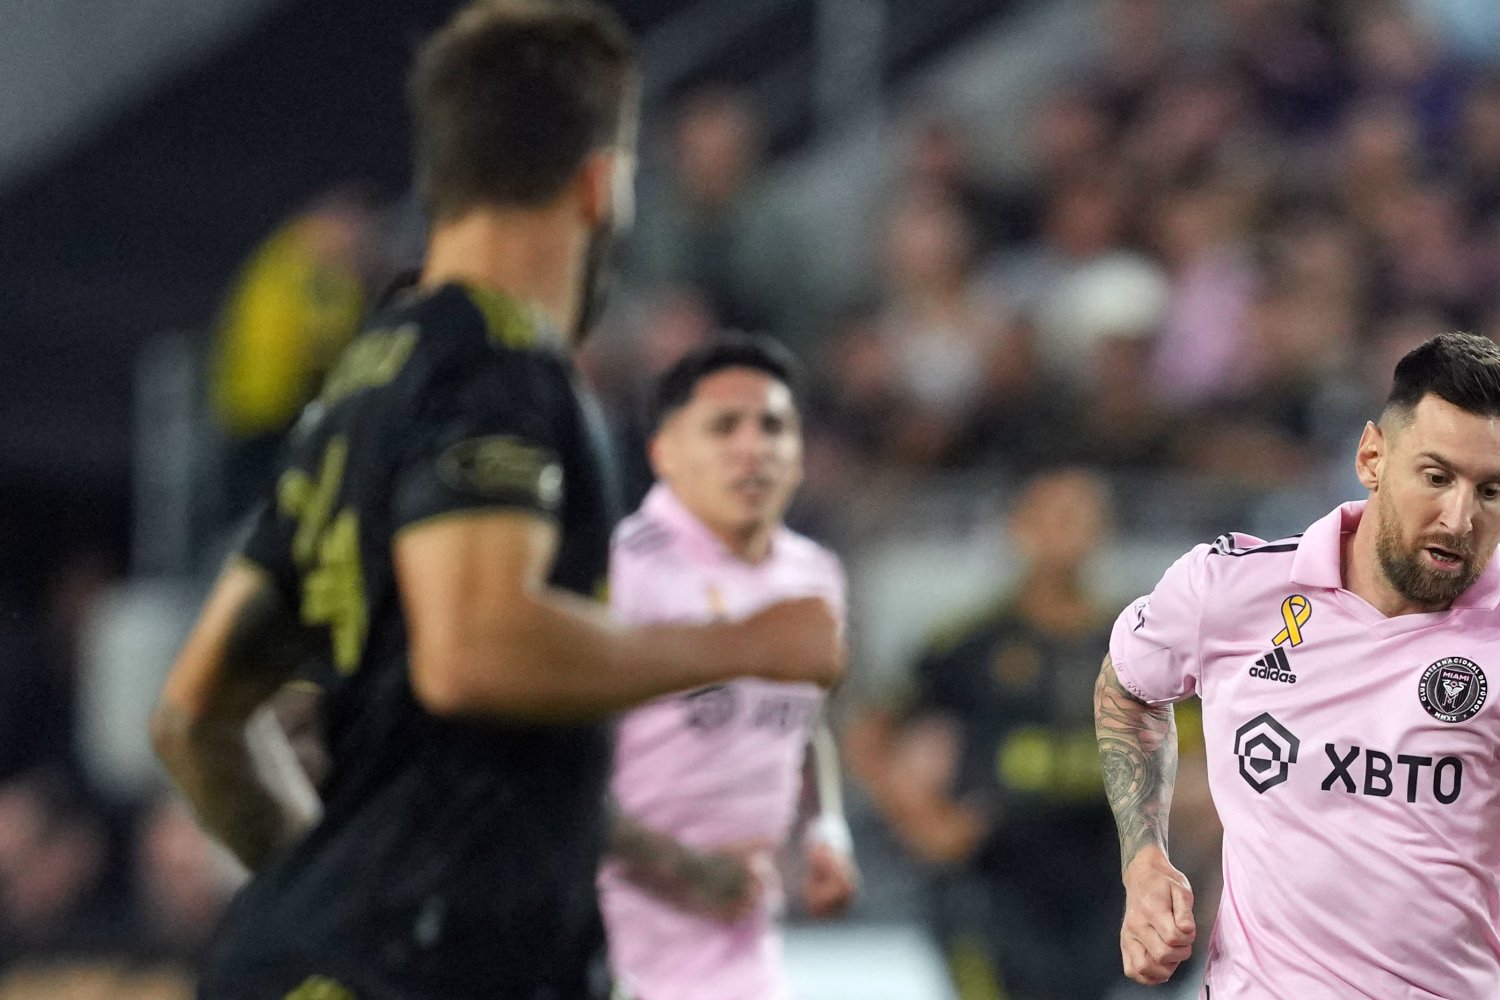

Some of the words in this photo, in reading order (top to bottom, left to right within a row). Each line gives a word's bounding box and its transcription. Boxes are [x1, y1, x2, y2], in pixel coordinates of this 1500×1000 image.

[1249, 666, 1297, 684] adidas
[1423, 658, 1480, 680] INTERNACIONAL
[1478, 675, 1485, 684] DE
[1443, 672, 1470, 681] MIAMI
[1435, 712, 1457, 721] MMXX
[1321, 743, 1463, 805] XBTO
